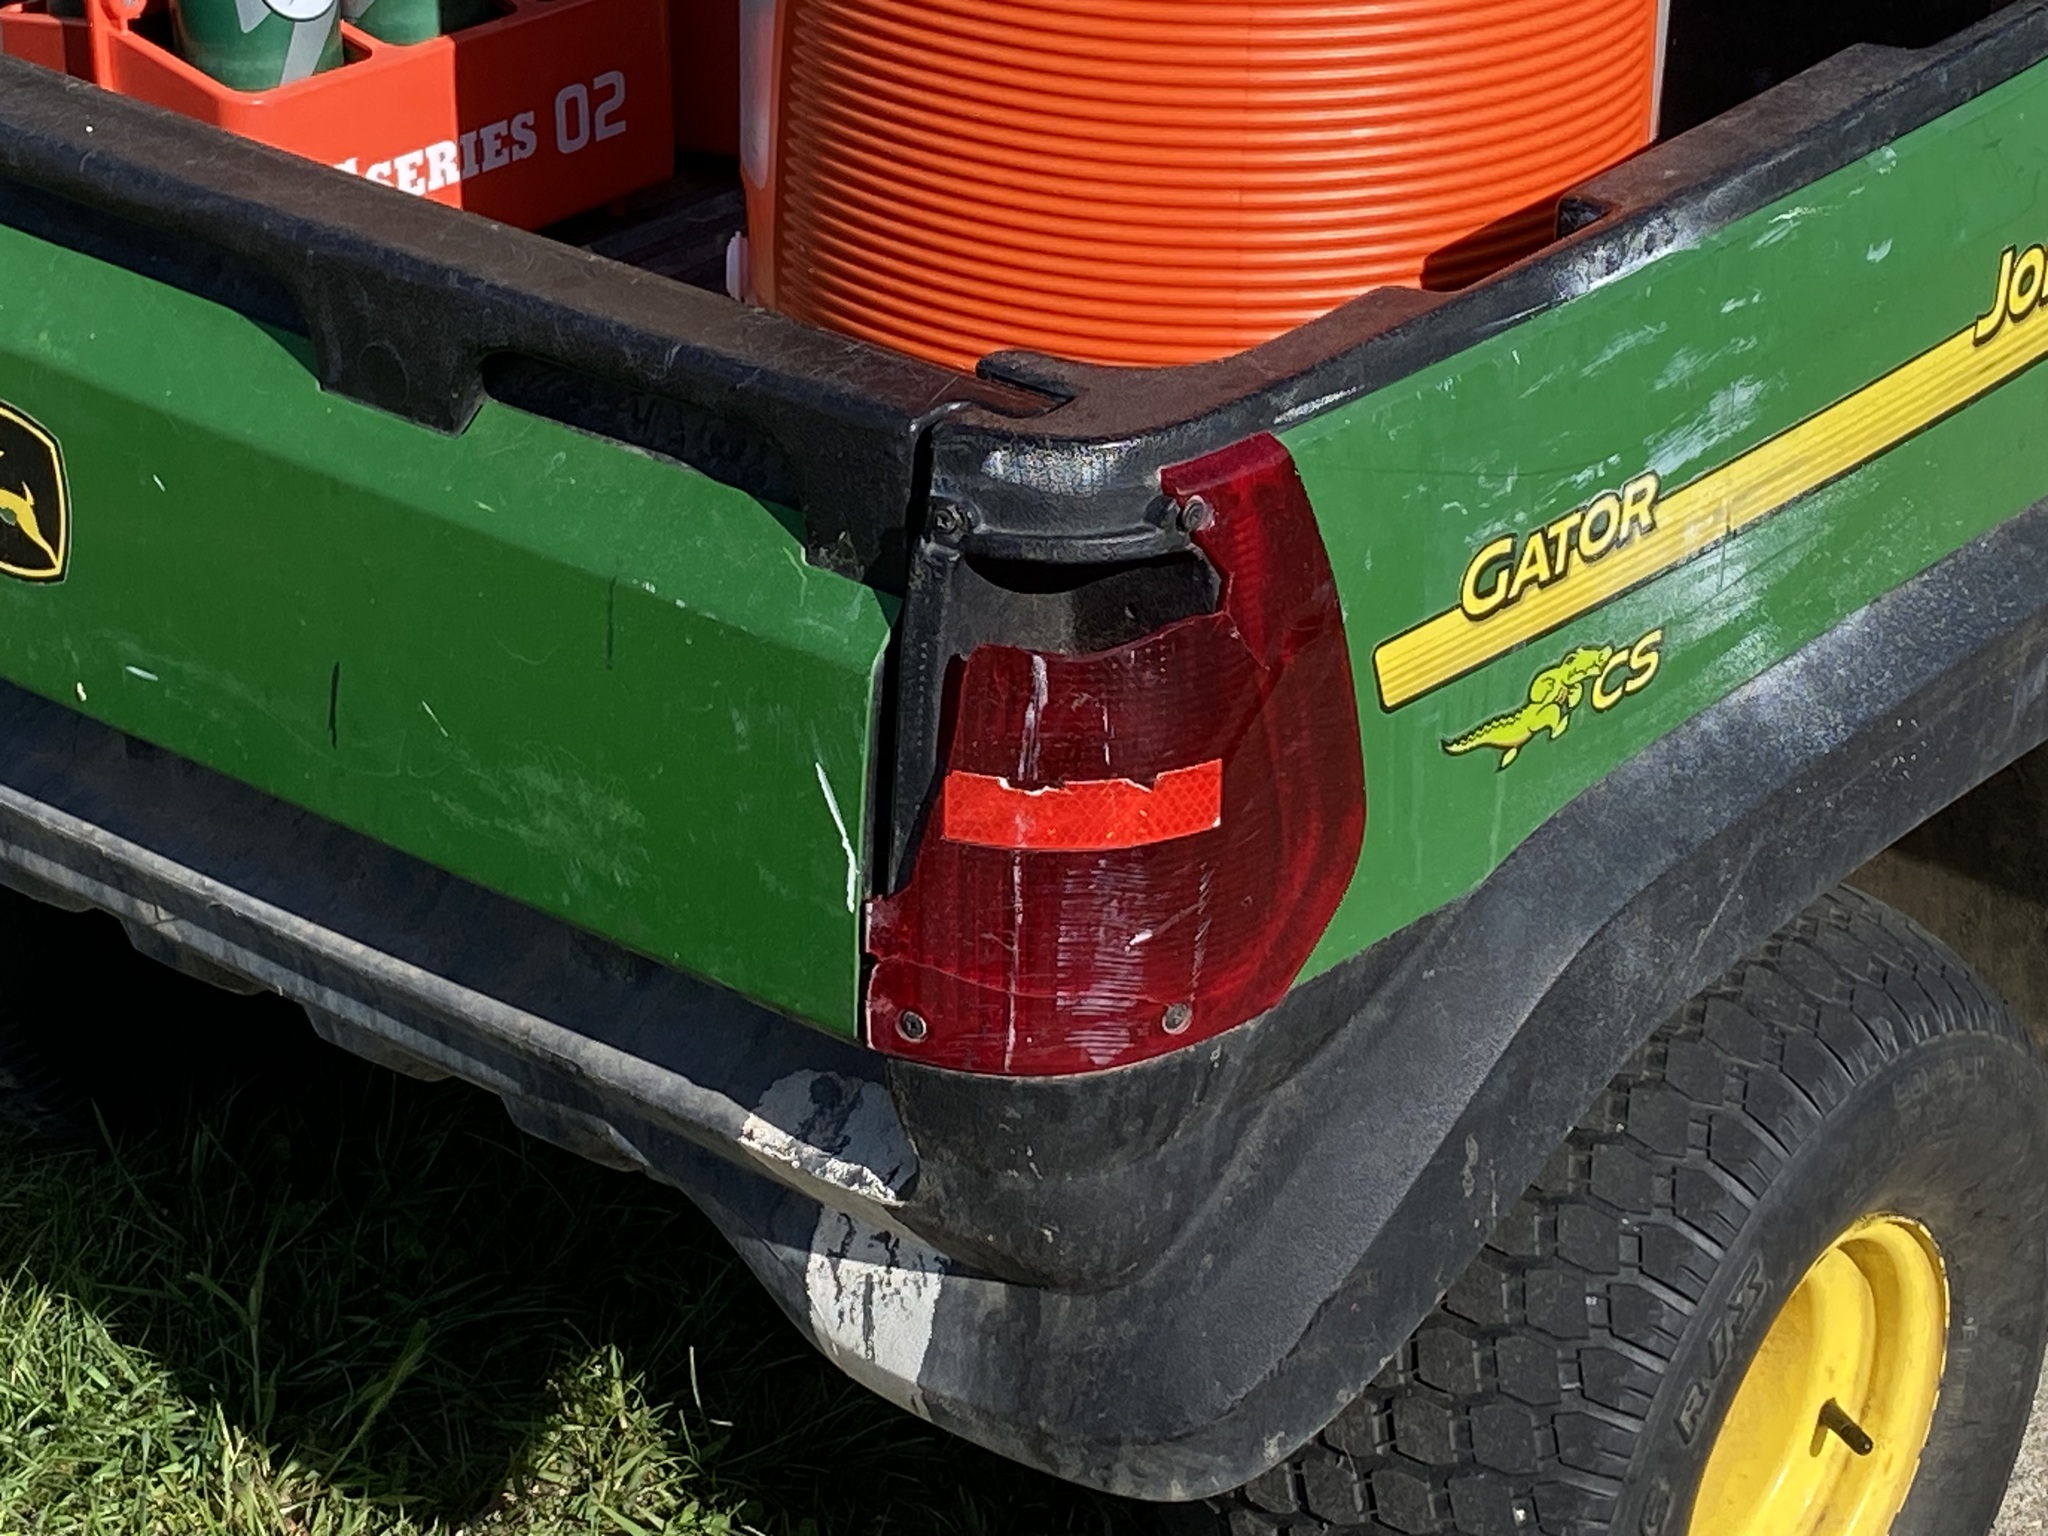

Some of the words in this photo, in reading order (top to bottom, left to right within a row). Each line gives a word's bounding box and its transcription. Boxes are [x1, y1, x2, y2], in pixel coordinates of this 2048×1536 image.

[555, 70, 627, 154] 02
[1973, 244, 2048, 347] JO
[1461, 470, 1661, 621] GATOR
[1591, 629, 1664, 711] CS
